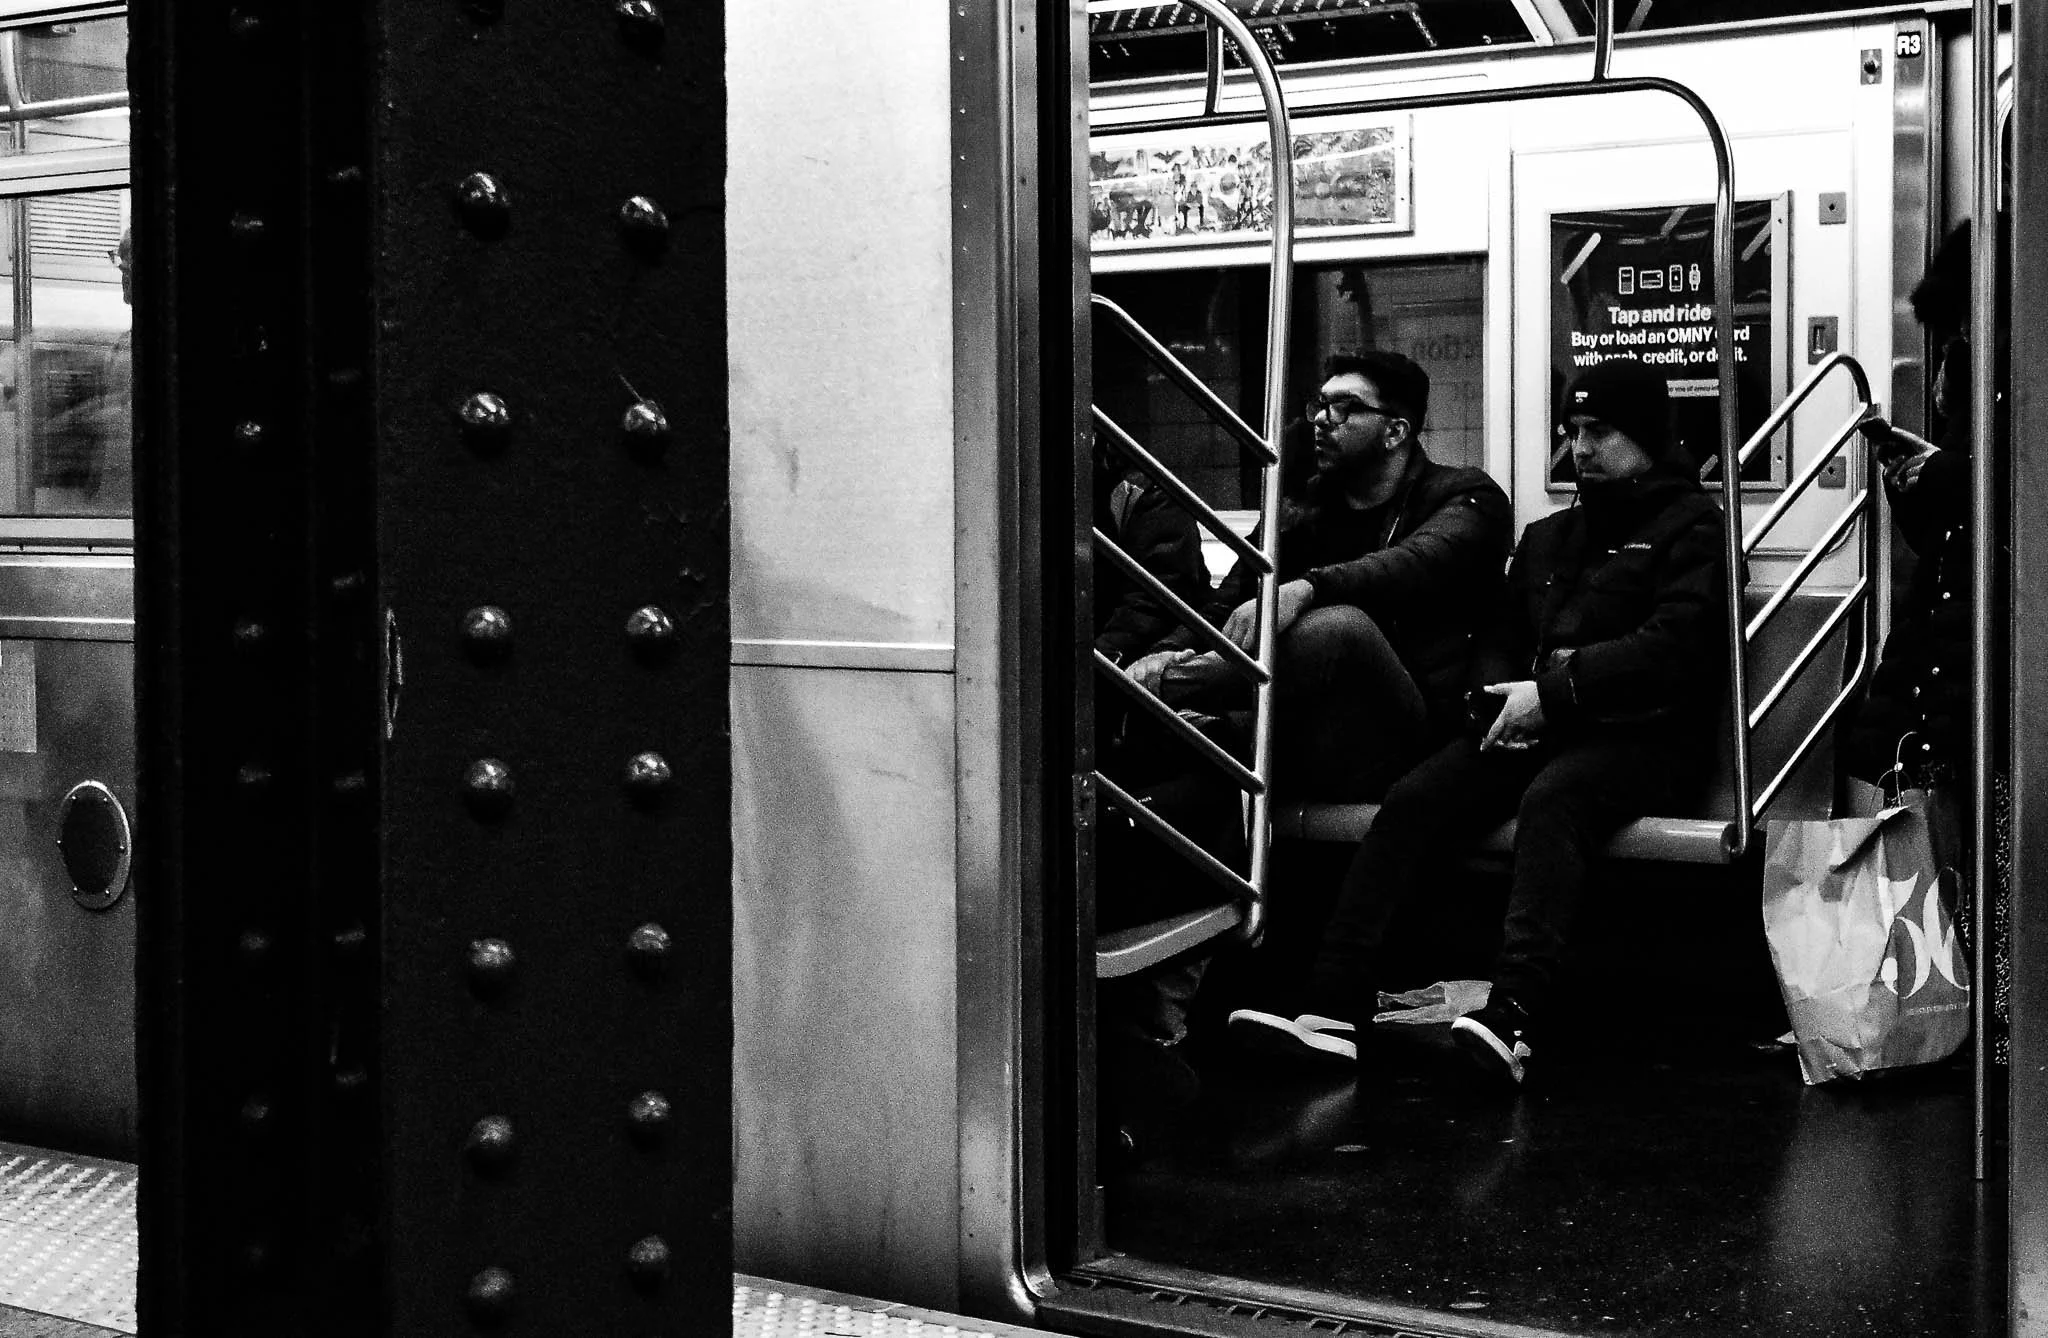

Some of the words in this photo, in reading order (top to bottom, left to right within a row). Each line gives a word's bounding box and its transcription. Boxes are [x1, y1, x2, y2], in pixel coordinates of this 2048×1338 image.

[1897, 34, 1921, 56] R3
[1607, 306, 1640, 327] Tap
[1641, 304, 1675, 323] and
[1677, 303, 1712, 322] ride
[1571, 331, 1598, 349] Buy
[1599, 333, 1615, 346] or
[1616, 329, 1646, 345] load
[1648, 332, 1665, 345] an
[1667, 326, 1713, 344] OMNY
[1714, 325, 1750, 342] rd
[1573, 350, 1604, 367] with
[1642, 348, 1688, 366] credit,
[1688, 350, 1705, 363] or
[1706, 347, 1748, 363] dit.
